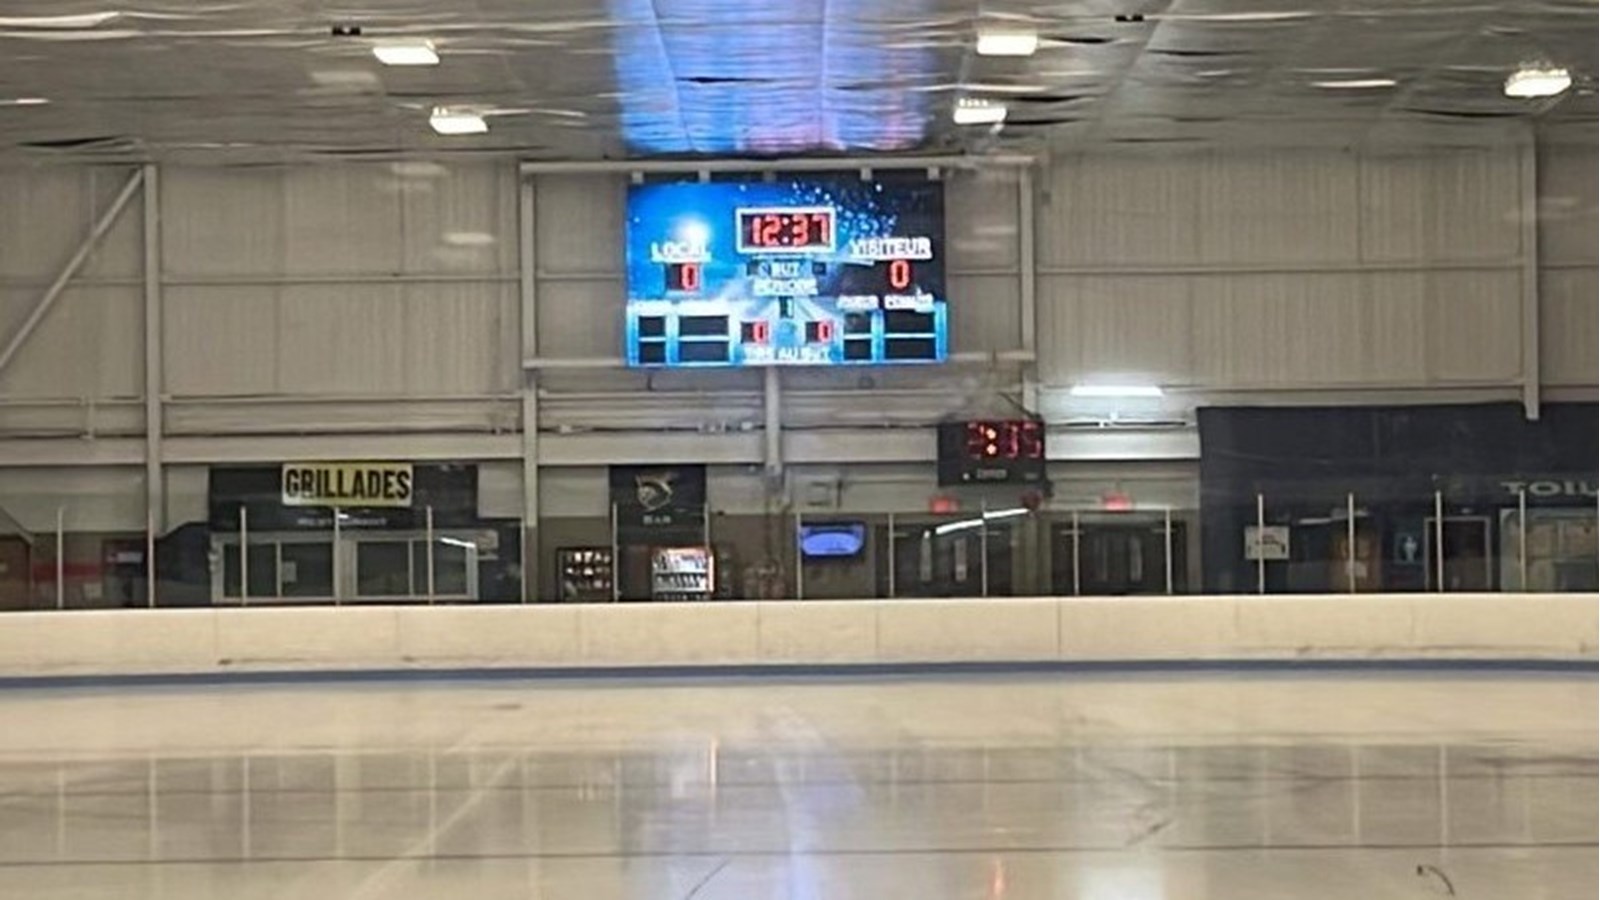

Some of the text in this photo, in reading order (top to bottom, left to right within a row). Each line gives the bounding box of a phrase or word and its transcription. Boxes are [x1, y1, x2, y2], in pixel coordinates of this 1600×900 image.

[752, 215, 829, 246] 12:37
[850, 238, 931, 258] VISITEUR
[682, 263, 698, 289] 0
[891, 260, 909, 288] 0
[753, 321, 768, 344] 0
[818, 321, 833, 344] 0
[286, 468, 410, 499] GRILLADES
[1500, 480, 1599, 497] TOIL
